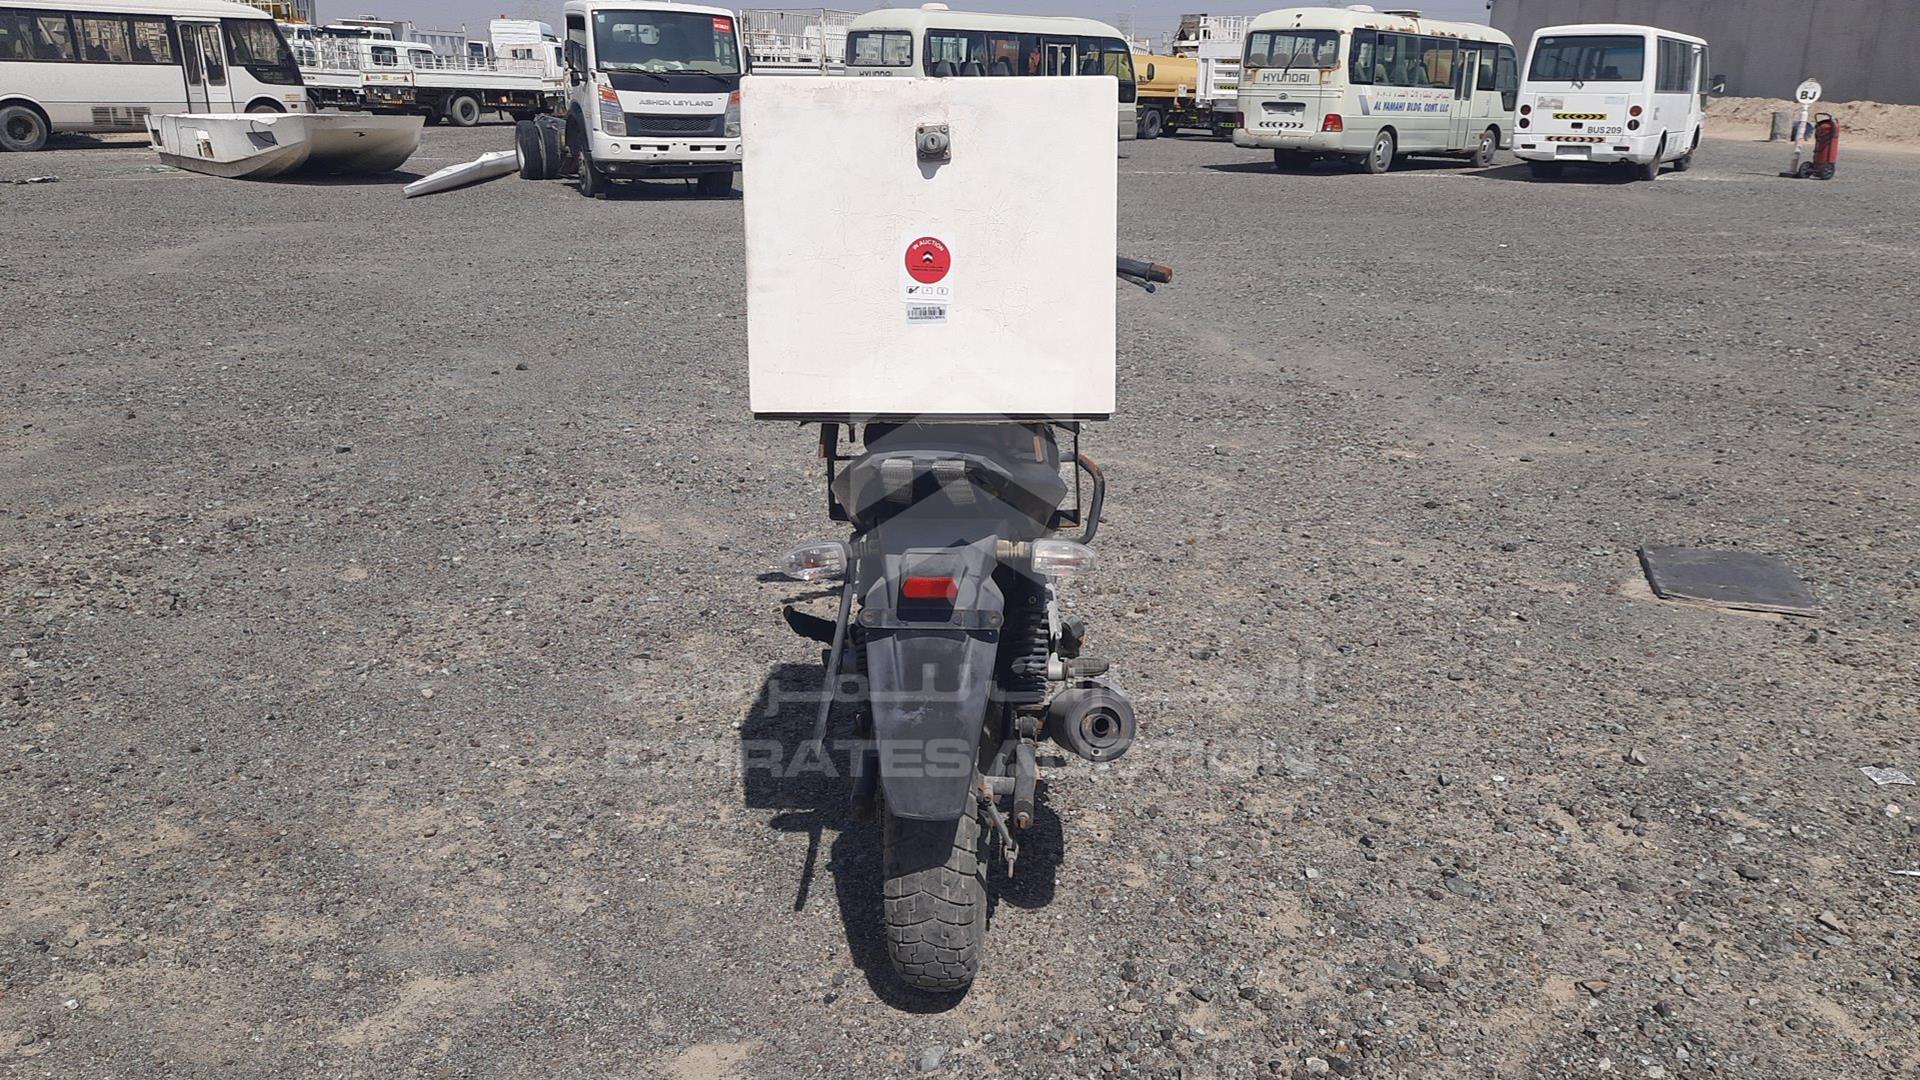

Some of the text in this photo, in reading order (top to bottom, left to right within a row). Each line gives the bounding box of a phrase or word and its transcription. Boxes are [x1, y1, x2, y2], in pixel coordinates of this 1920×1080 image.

[1262, 73, 1310, 83] HYUNDAI
[1800, 90, 1817, 100] BJ
[1373, 101, 1381, 111] AL
[1383, 101, 1406, 112] YAMAHI
[1440, 103, 1450, 113] LLC
[919, 239, 944, 251] AUCTION
